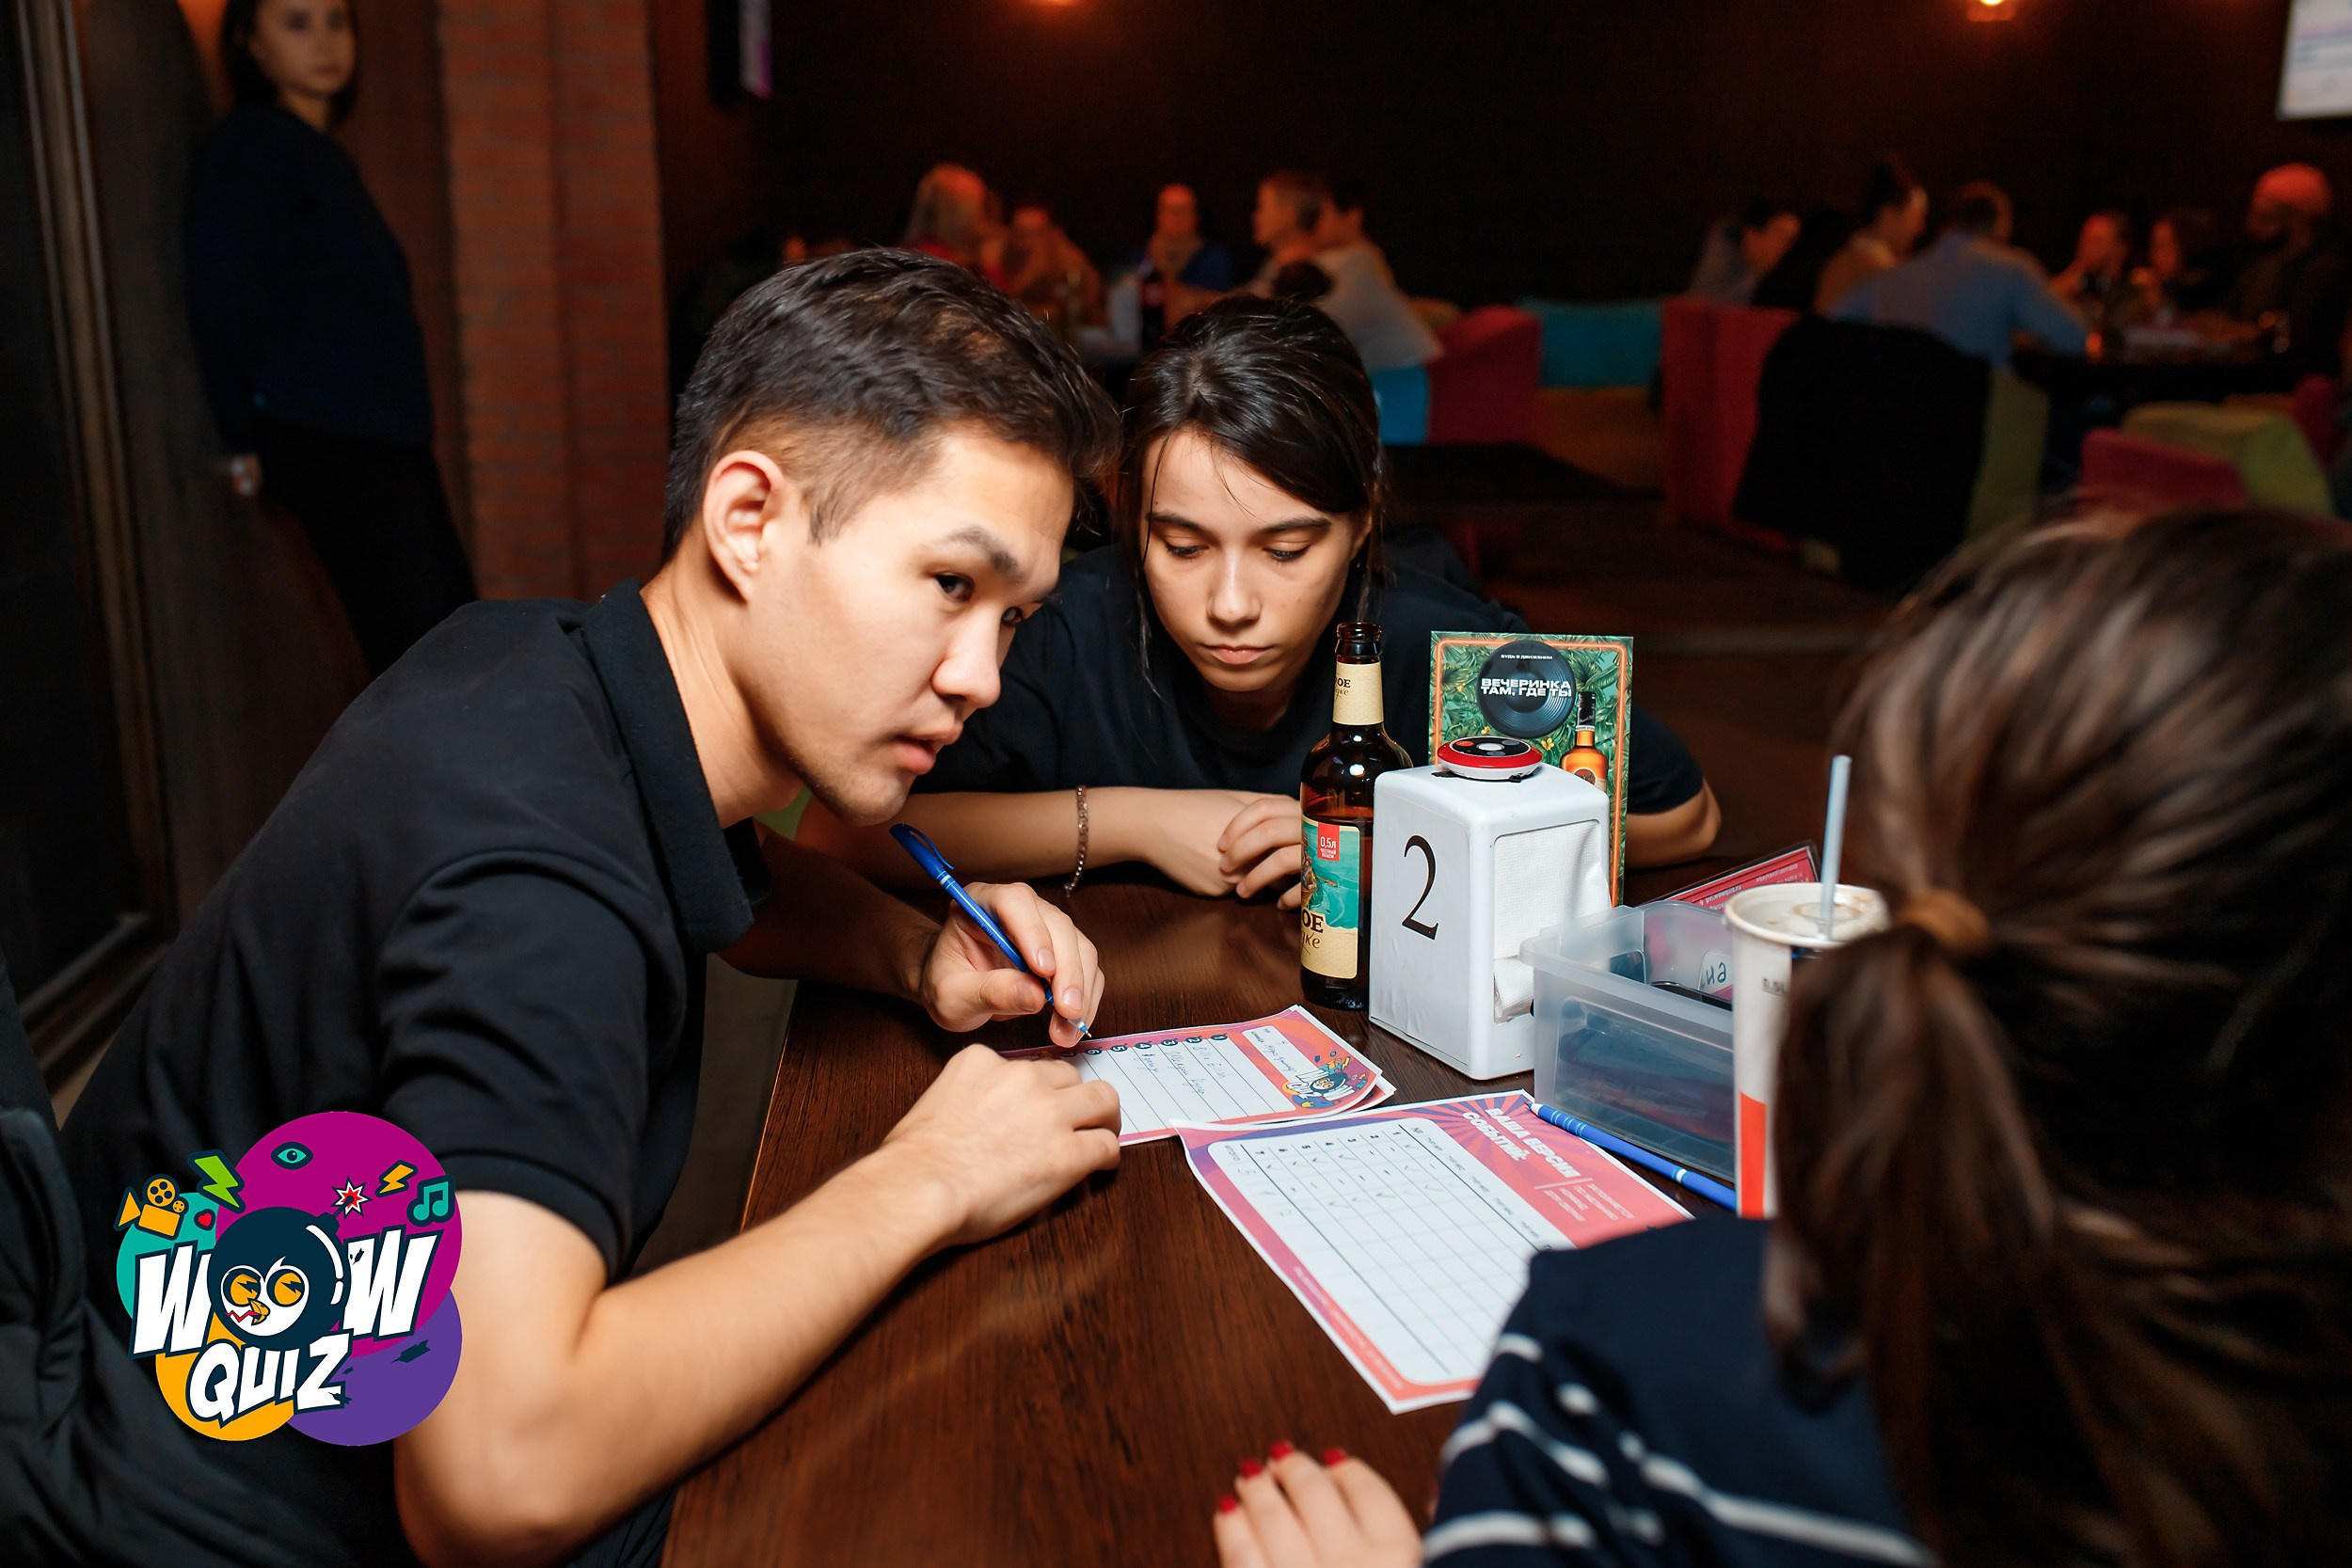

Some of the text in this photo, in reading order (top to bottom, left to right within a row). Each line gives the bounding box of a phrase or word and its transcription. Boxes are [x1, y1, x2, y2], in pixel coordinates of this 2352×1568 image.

[1481, 678, 1571, 689] ВЕЧЕРИНКА
[1481, 686, 1572, 697] ТАМ, ГДЕ ТЫ
[1401, 834, 1439, 941] 2
